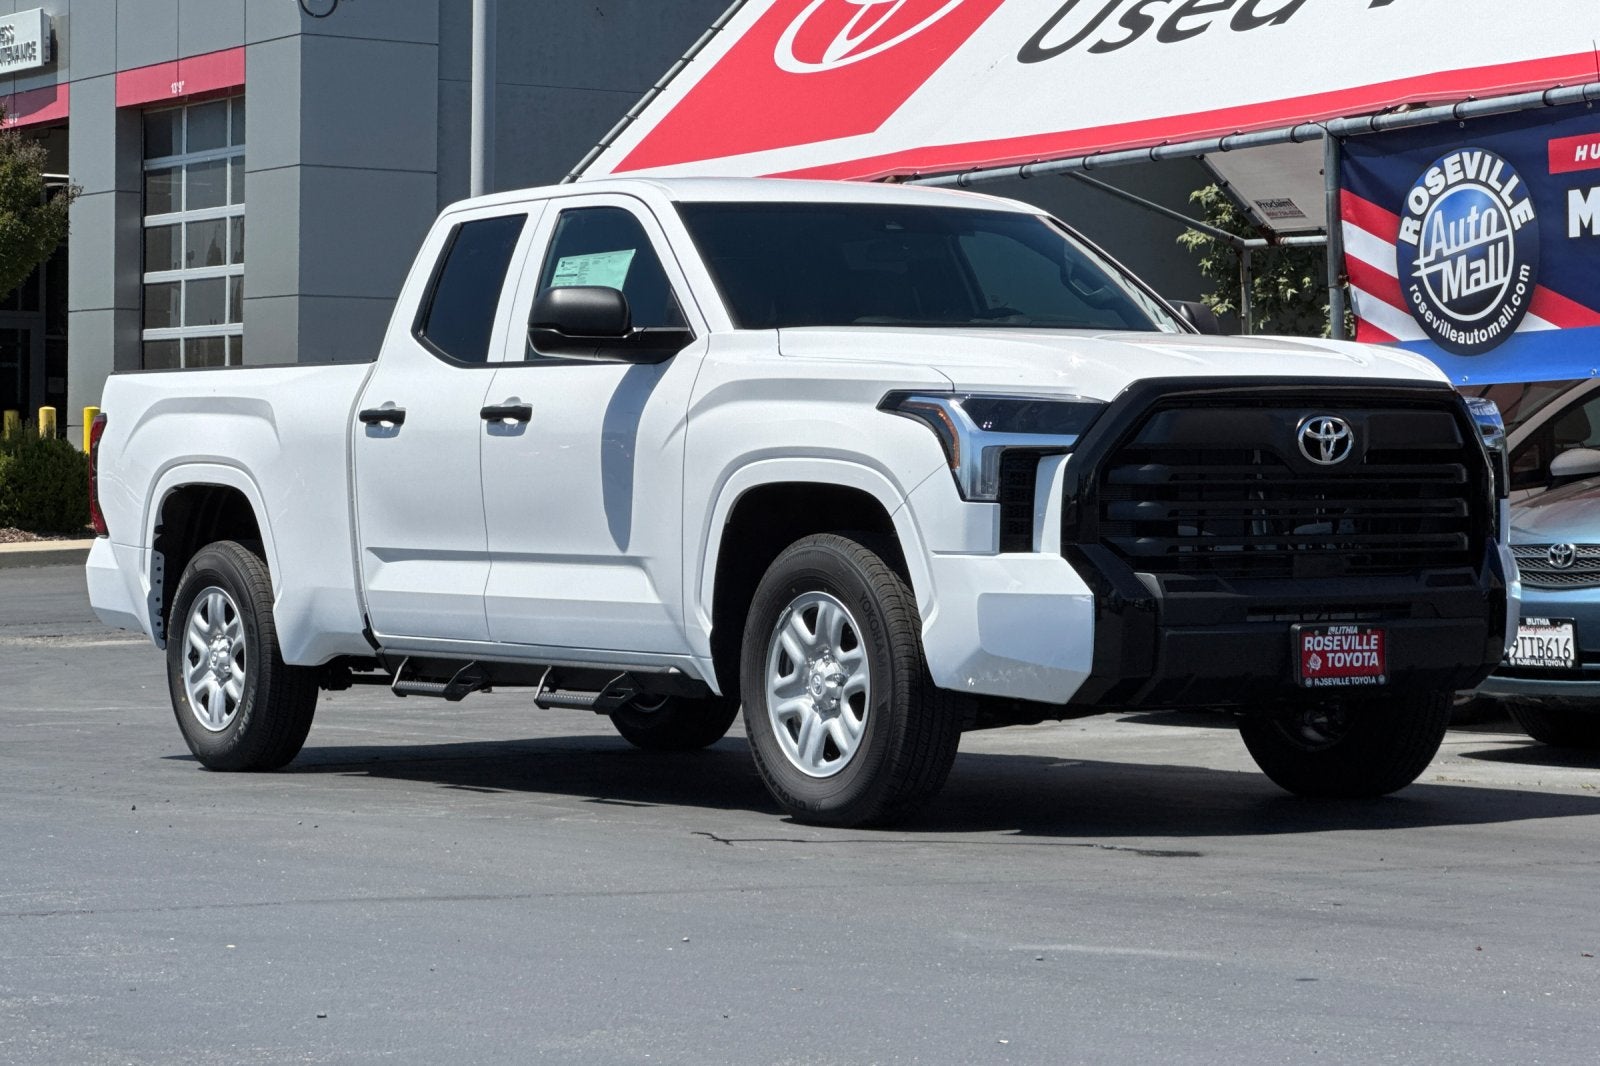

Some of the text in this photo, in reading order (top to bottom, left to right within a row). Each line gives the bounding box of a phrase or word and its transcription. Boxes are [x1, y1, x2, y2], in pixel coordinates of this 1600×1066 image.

[1399, 151, 1535, 246] ROSEVILLE
[1422, 205, 1502, 261] Auto
[1434, 241, 1505, 303] Mall
[1409, 263, 1531, 345] rosevilleautomall.com
[1304, 635, 1379, 651] ROSEVILLE
[1334, 625, 1358, 635] LITHIA
[1326, 652, 1379, 668] TOYOTA
[1314, 676, 1377, 687] ROSEVILLE TOYOTA
